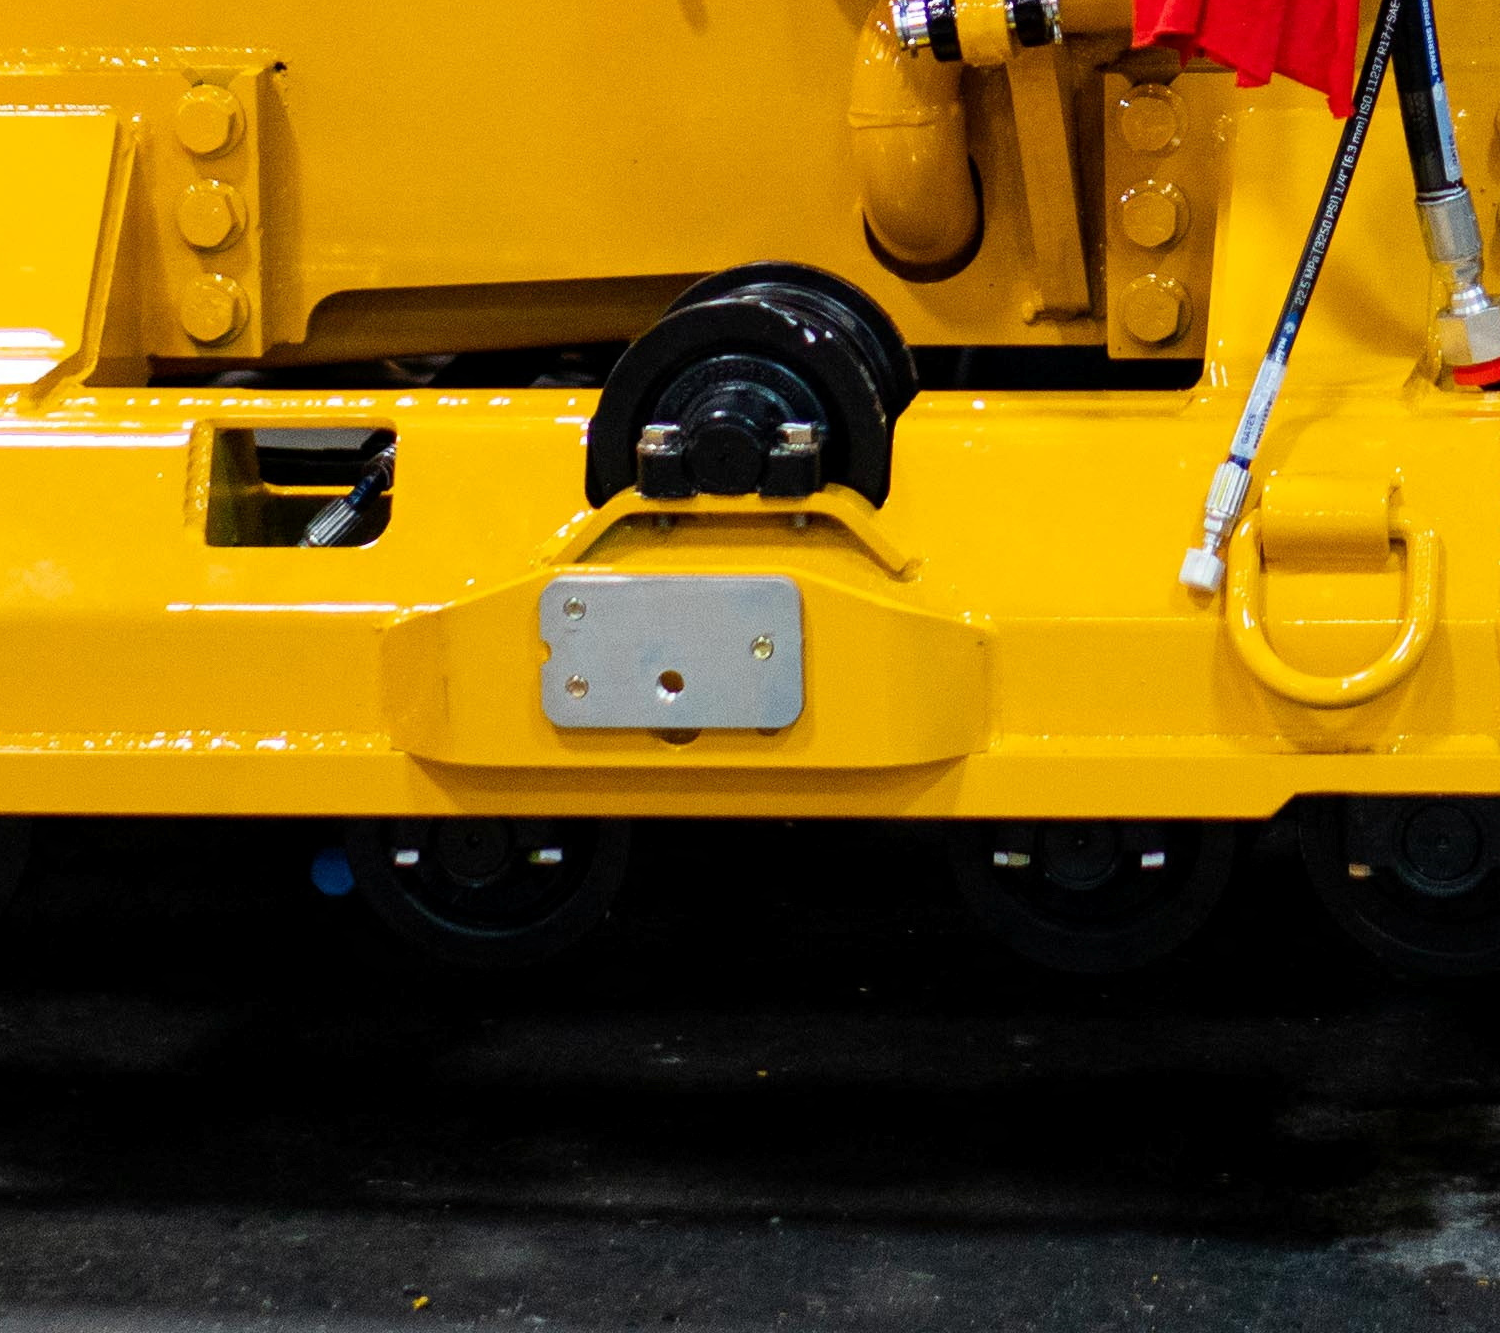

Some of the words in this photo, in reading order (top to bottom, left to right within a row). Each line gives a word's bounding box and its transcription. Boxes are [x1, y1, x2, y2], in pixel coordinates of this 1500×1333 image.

[1385, 0, 1401, 24] SAE
[1375, 29, 1393, 55] R17
[1362, 54, 1386, 94] 11237
[1357, 93, 1374, 115] ISO
[1302, 252, 1321, 280] MPa
[1293, 279, 1312, 306] 22.5
[1239, 412, 1258, 445] GATES
